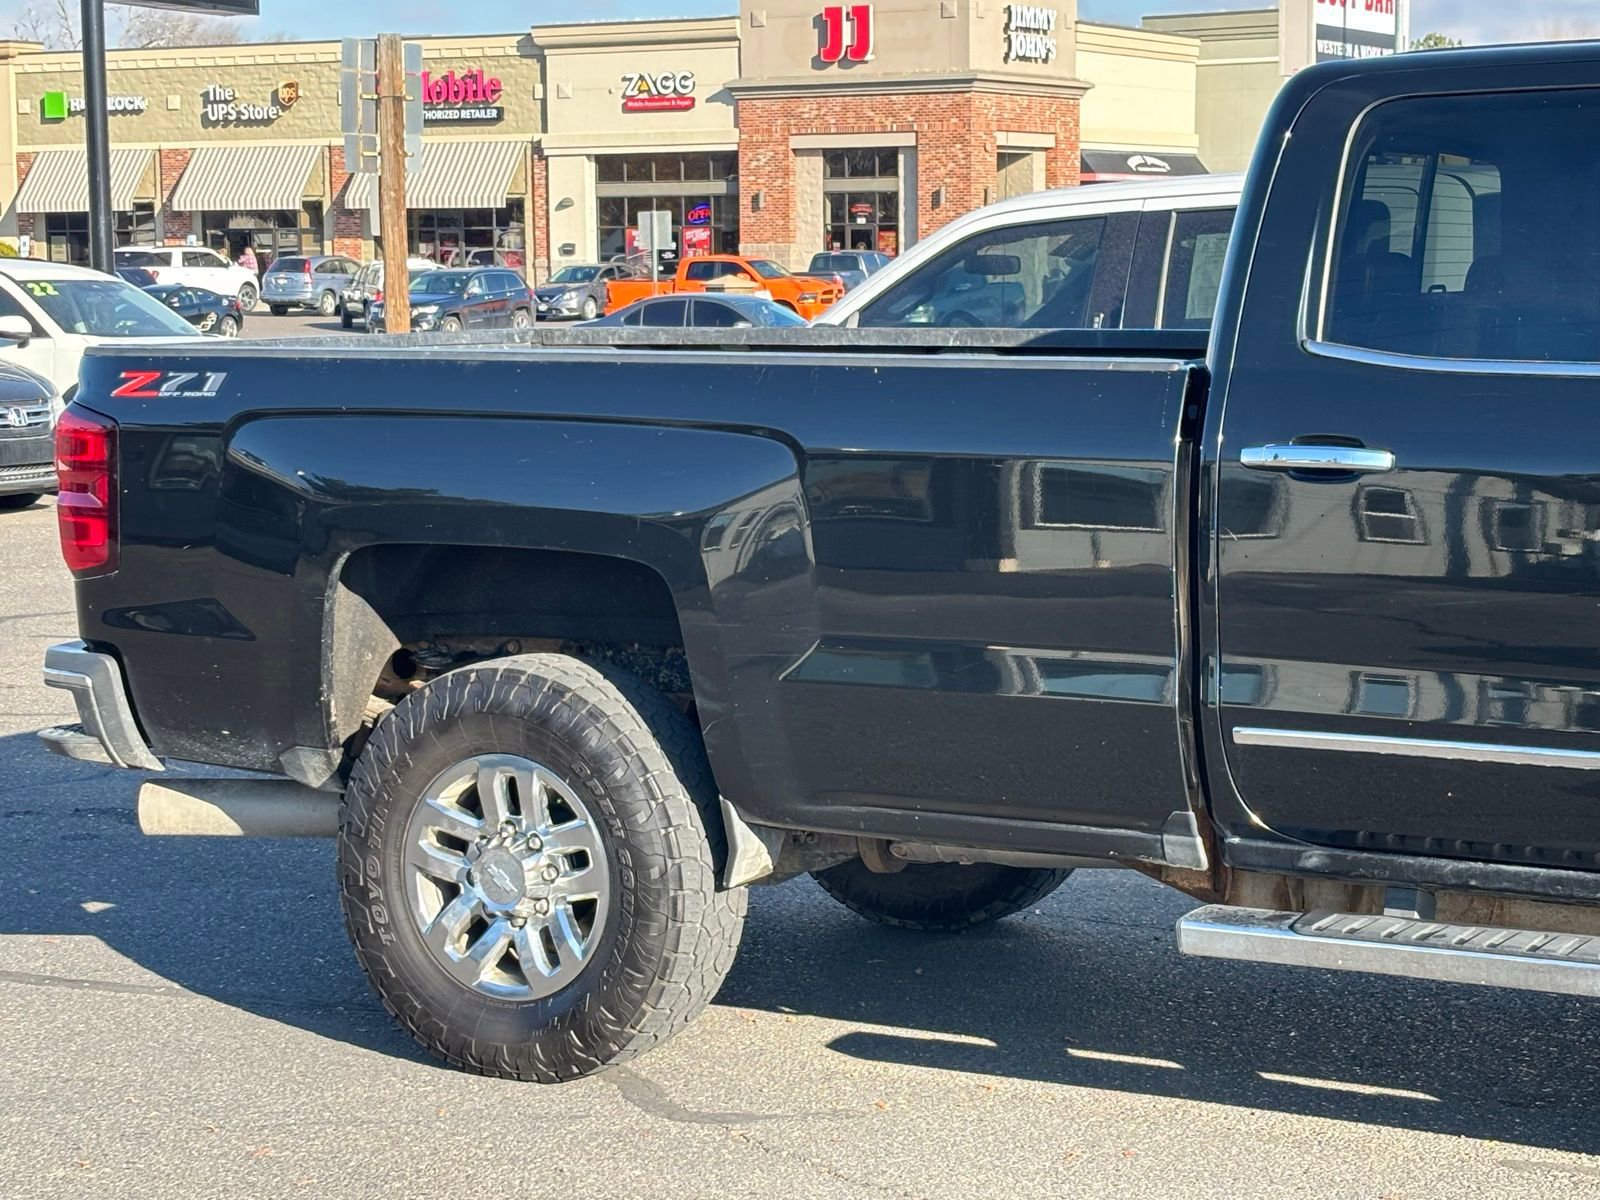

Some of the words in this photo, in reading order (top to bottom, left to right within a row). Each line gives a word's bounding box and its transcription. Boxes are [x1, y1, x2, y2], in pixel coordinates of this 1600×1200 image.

[1008, 5, 1057, 31] JIMMY
[821, 4, 873, 62] JJ
[1008, 33, 1057, 61] JOHN'S
[208, 84, 234, 101] The
[421, 68, 502, 104] obile
[624, 71, 694, 96] ZAGG
[106, 96, 144, 111] LOCK
[207, 103, 237, 121] UPS
[240, 103, 278, 120] Store
[460, 109, 498, 119] RETAILER
[26, 282, 60, 296] 22
[110, 371, 228, 398] Z71
[569, 759, 626, 840] OPEN
[365, 855, 397, 947] TOYO
